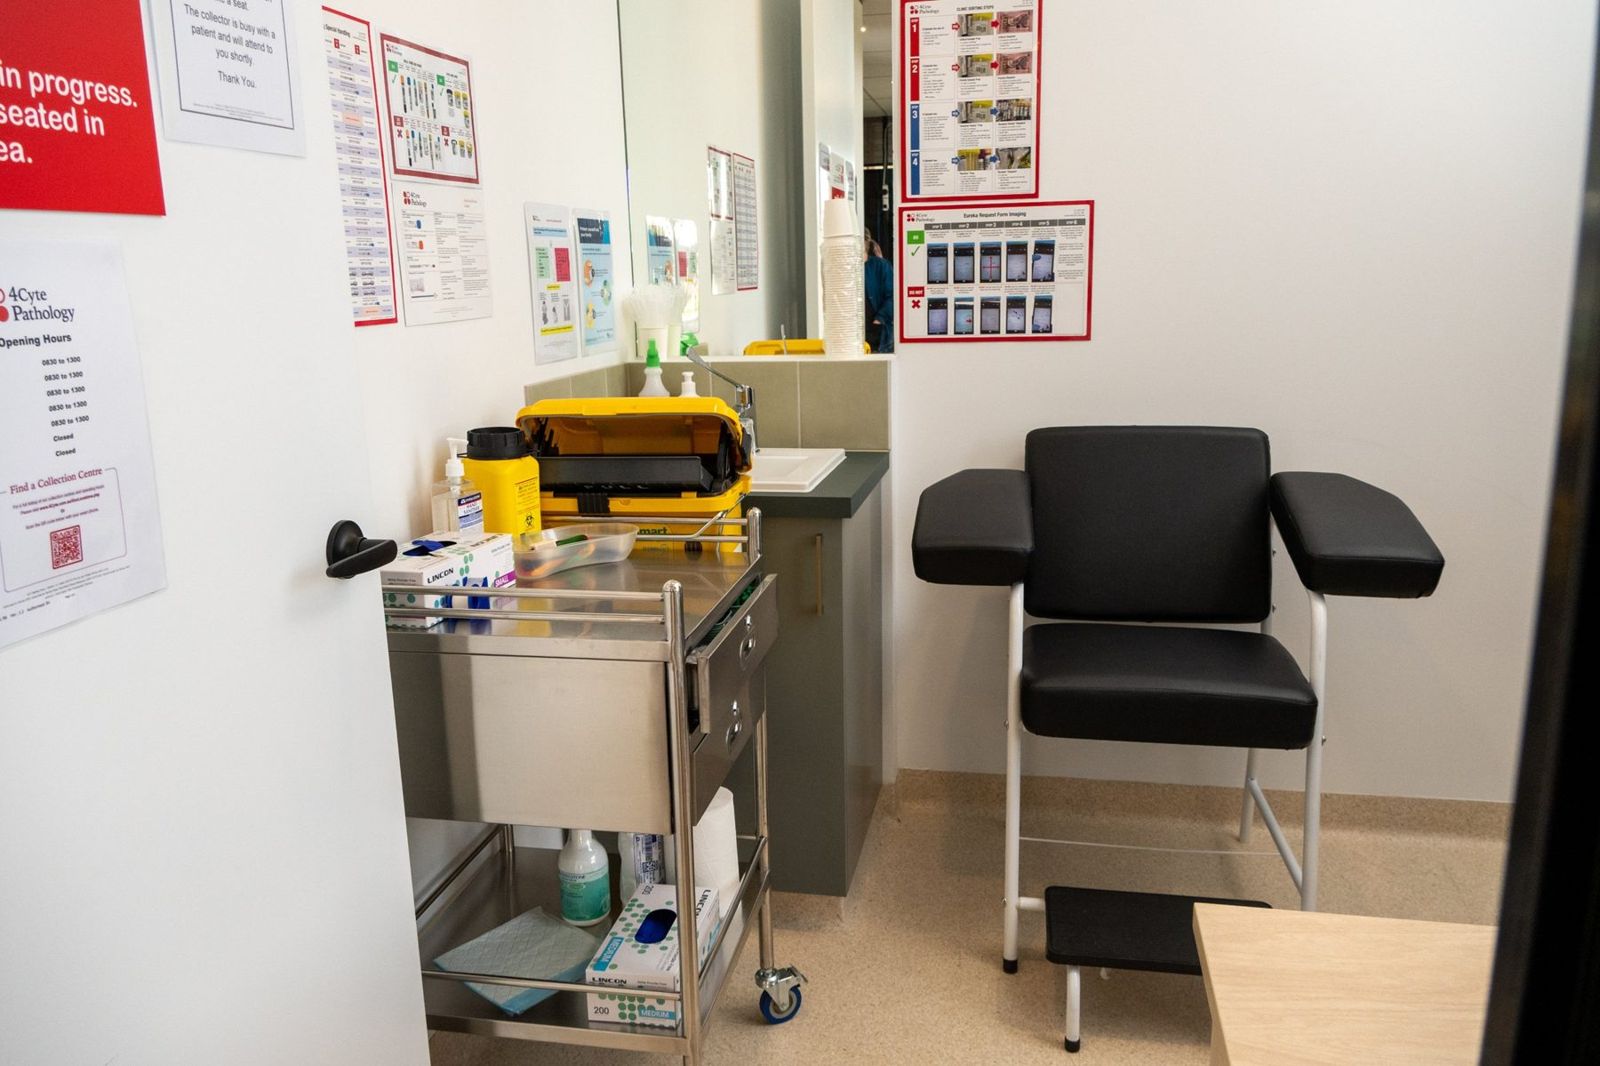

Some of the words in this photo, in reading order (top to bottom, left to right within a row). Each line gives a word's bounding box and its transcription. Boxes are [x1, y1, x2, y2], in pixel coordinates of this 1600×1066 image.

[233, 0, 249, 10] seat.
[184, 4, 199, 17] The
[201, 11, 230, 26] collector
[232, 19, 238, 28] is
[240, 22, 256, 35] busy
[257, 27, 270, 37] with
[272, 31, 276, 39] a
[912, 24, 916, 32] 1
[192, 25, 216, 39] patient
[218, 32, 231, 43] and
[232, 36, 244, 46] will
[245, 40, 266, 52] attend
[267, 45, 273, 54] to
[216, 48, 229, 59] you
[912, 65, 918, 73] 2
[218, 70, 240, 84] Thank
[28, 70, 138, 108] progress.
[0, 102, 78, 133] seated
[84, 108, 105, 136] in
[912, 110, 918, 118] 3
[8, 286, 47, 306] 4Cyte
[12, 305, 75, 322] Pathology
[0, 336, 40, 348] Opening
[42, 334, 72, 344] Hours
[53, 433, 74, 442] Closed
[55, 448, 76, 456] Closed
[10, 483, 29, 494] Find
[38, 474, 76, 488] Collection
[78, 468, 103, 479] Centre
[637, 526, 668, 535] mart
[427, 568, 454, 584] LINCON
[696, 889, 711, 916] LINCO
[594, 1006, 609, 1015] 200
